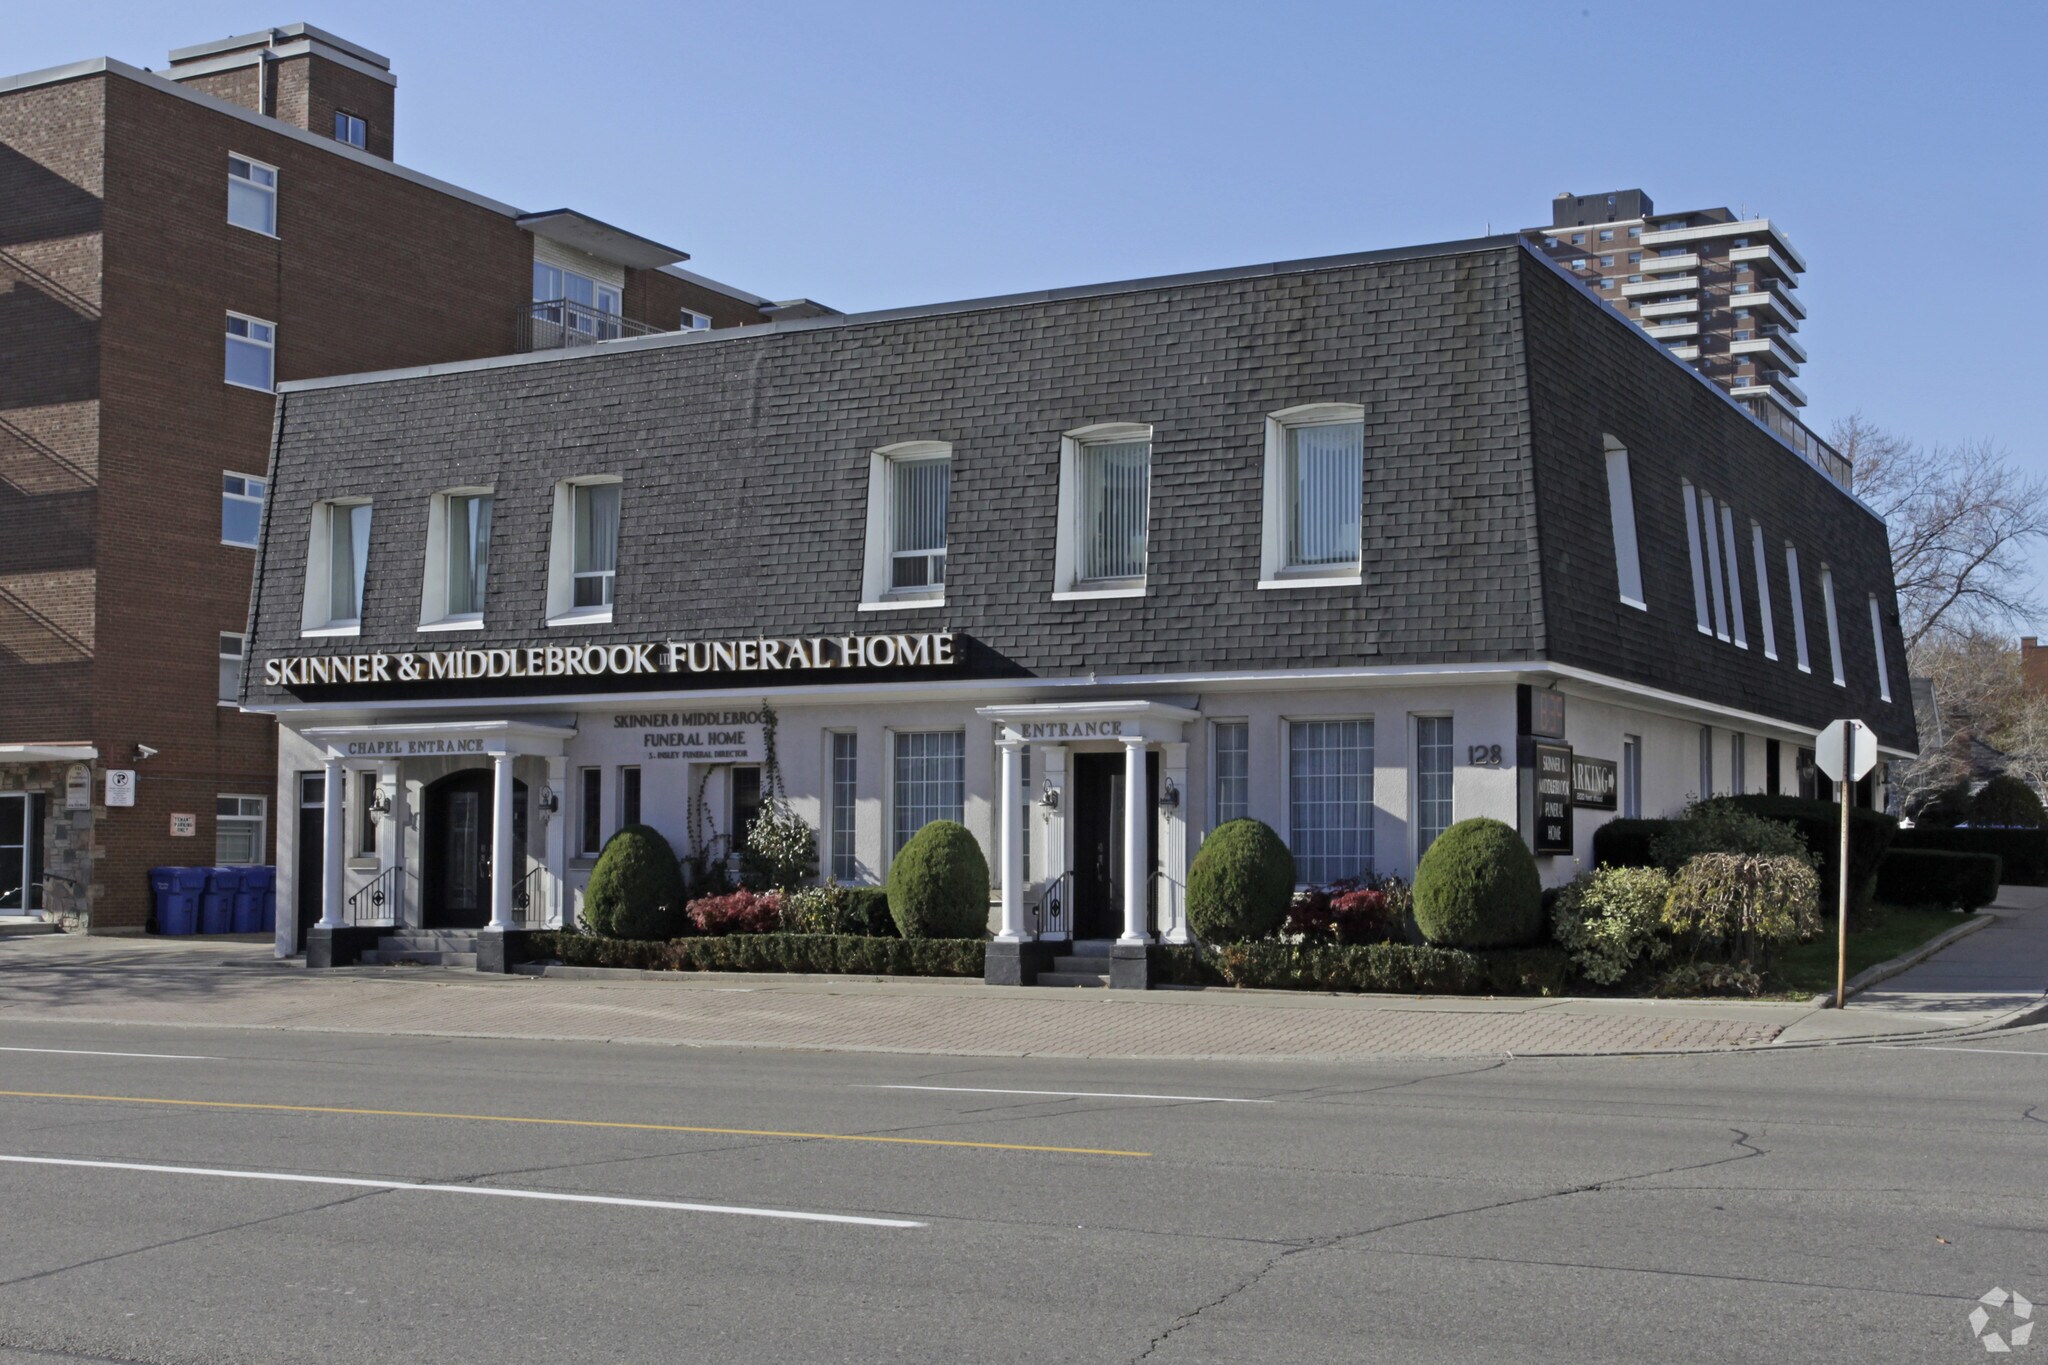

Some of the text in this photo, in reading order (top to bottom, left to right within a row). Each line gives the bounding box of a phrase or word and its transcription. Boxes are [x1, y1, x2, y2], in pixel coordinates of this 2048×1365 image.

[265, 654, 391, 685] SKINNER
[397, 652, 421, 681] &
[428, 643, 658, 680] MIDDLEBROOK
[669, 638, 831, 673] FUNERAL
[840, 634, 954, 667] HOME
[614, 713, 670, 728] SKINNER
[671, 713, 679, 727] &
[1021, 721, 1122, 738] ENTRANCE
[348, 739, 484, 755] CHAPEL ENTRANCE
[644, 731, 745, 747] FUNERAL HOME
[682, 750, 713, 759] FUNERAL
[714, 750, 748, 758] DIRECTOR
[1468, 744, 1502, 766] 128
[1543, 755, 1560, 772] SKINNER
